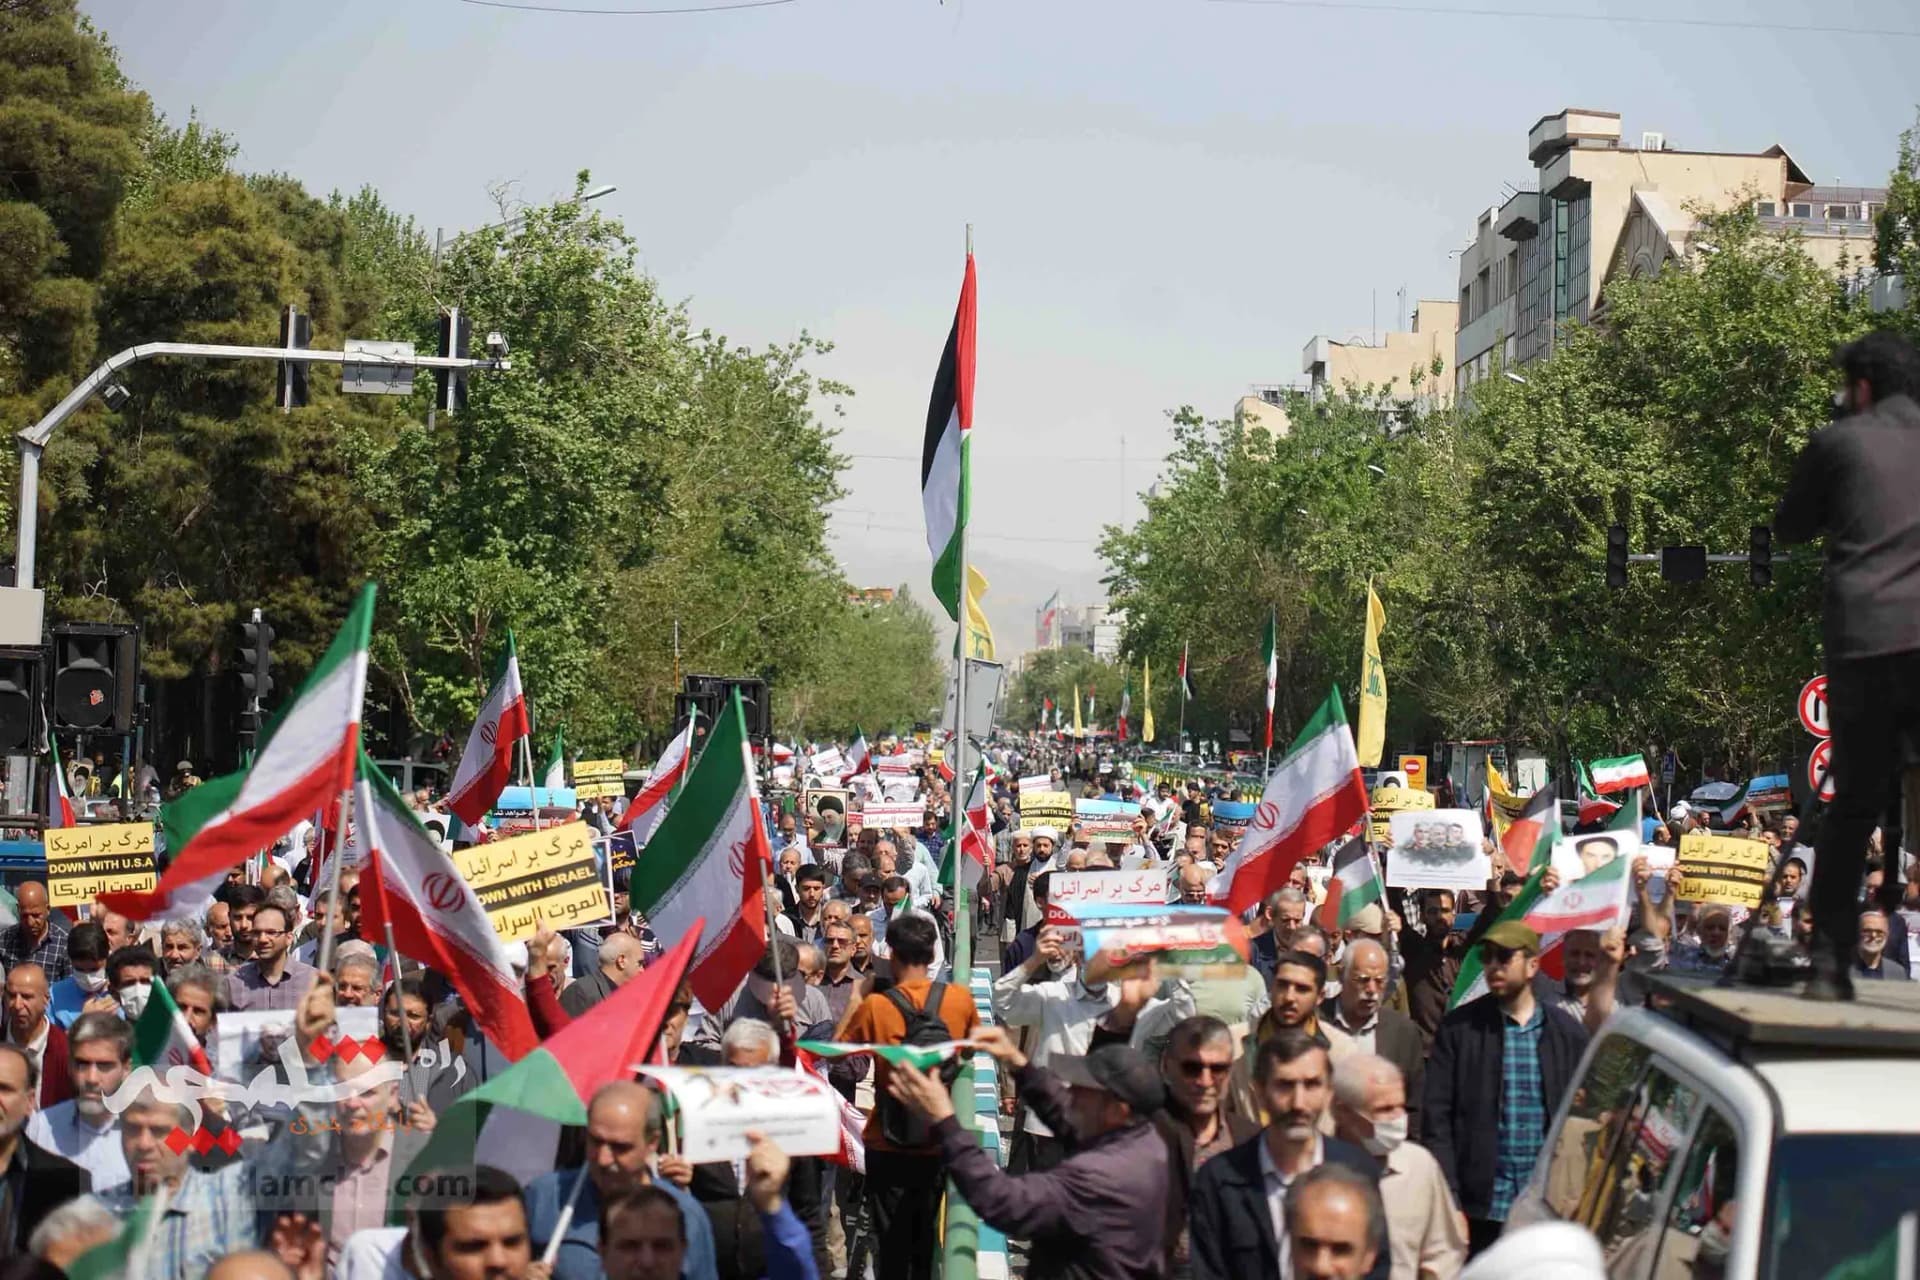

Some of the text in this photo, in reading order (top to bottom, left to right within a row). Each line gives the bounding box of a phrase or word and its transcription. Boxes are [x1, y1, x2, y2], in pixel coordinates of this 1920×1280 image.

[50, 831, 150, 856] مرگ بر امریکا
[48, 857, 154, 875] DOWN WITH U.S.A
[464, 835, 584, 883] مرگ بر اسرائیل
[110, 877, 153, 893] الموت
[477, 866, 597, 906] OWN WITH ISRAEL
[1053, 875, 1161, 900] مرگ بر اسرائیل
[547, 888, 604, 920] الموت
[1048, 909, 1071, 920] DO
